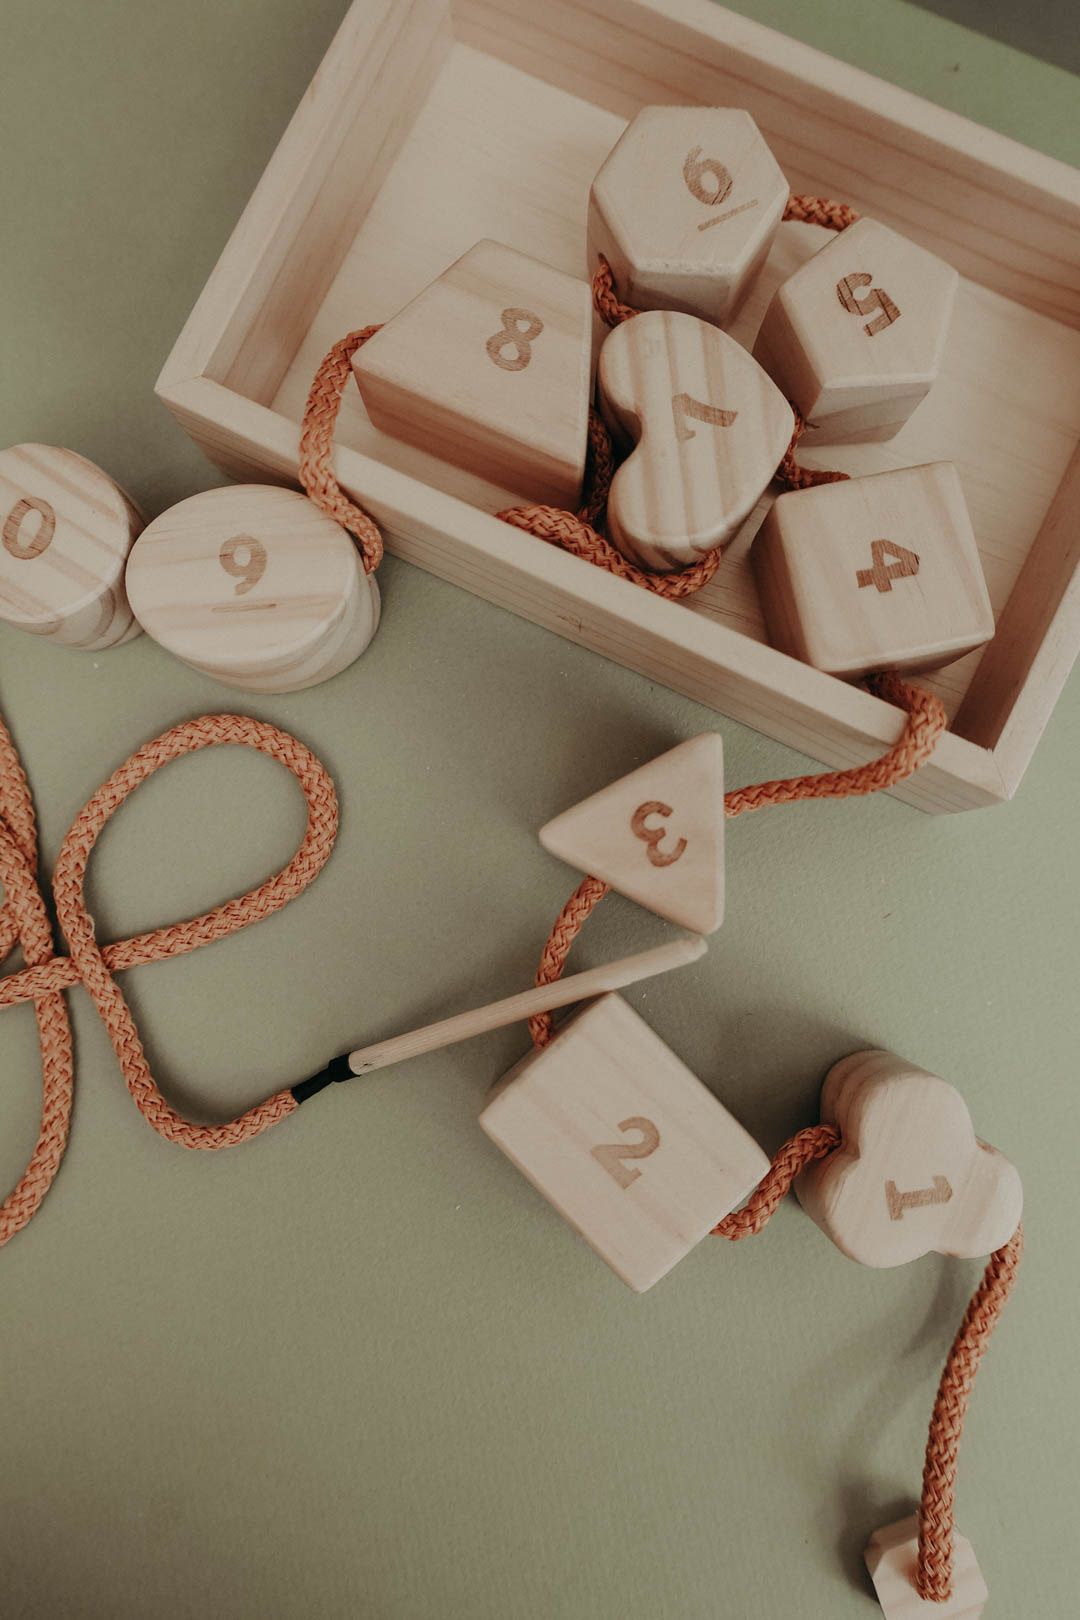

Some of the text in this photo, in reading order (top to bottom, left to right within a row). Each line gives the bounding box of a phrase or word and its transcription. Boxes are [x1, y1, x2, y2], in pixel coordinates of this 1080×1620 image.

[835, 272, 901, 337] 5
[485, 307, 544, 372] 8
[671, 392, 738, 441] 7
[2, 496, 56, 560] 0
[218, 533, 268, 595] 9
[855, 537, 920, 593] 4
[630, 800, 688, 868] 3
[591, 1115, 661, 1190] 2
[884, 1174, 954, 1221] 1
